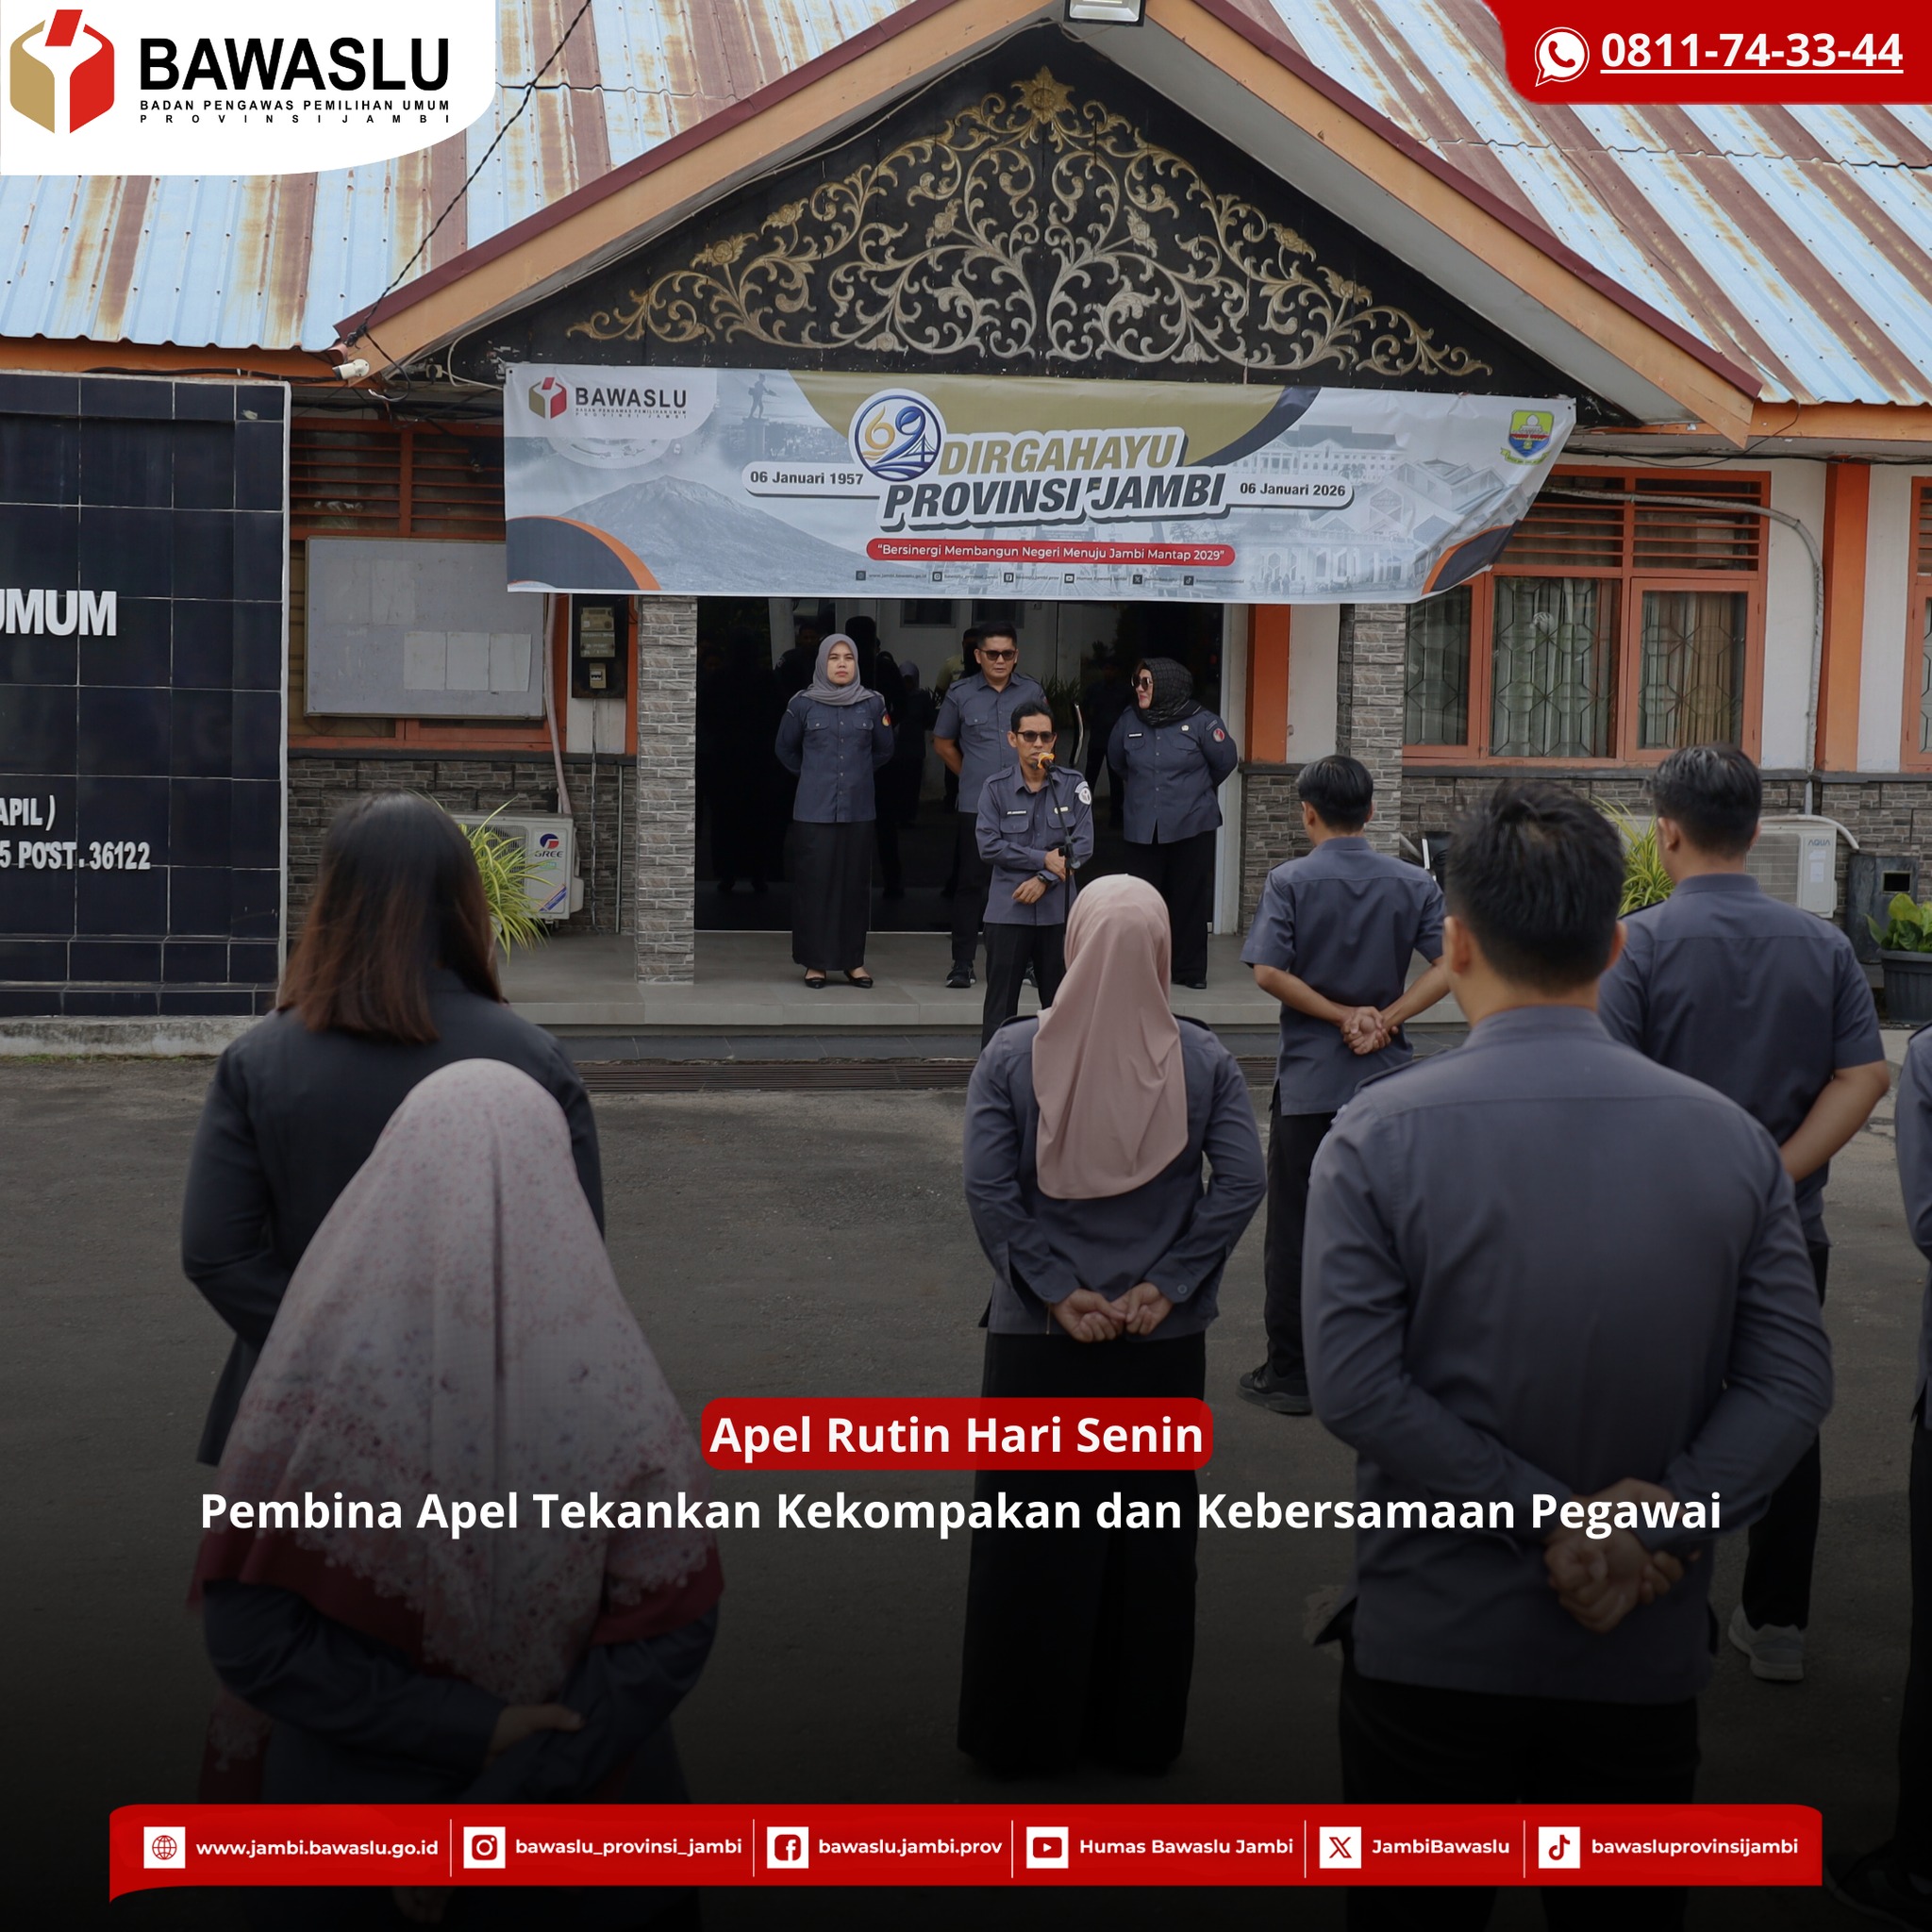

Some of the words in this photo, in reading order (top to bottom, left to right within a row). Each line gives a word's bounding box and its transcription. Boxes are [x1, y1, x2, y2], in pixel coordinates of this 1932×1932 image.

[575, 387, 687, 408] BAWASLU
[938, 434, 1178, 475] DIRGAHAYU
[750, 471, 768, 483] 06
[773, 472, 824, 485] Januari
[830, 473, 864, 485] 1957
[883, 477, 1082, 519] PROVINSI
[1091, 473, 1226, 511] JAMBI
[1240, 482, 1257, 494] 06
[1259, 483, 1309, 495] Januari
[1312, 484, 1346, 496] 2026
[944, 545, 1019, 558] Membangun
[1022, 546, 1060, 558] Negeri
[1063, 547, 1107, 560] Menuju
[1109, 548, 1144, 559] Jambi
[1147, 548, 1191, 561] Mantap
[0, 588, 117, 637] MUM
[1807, 838, 1831, 846] AQUA
[534, 850, 564, 858] GREE
